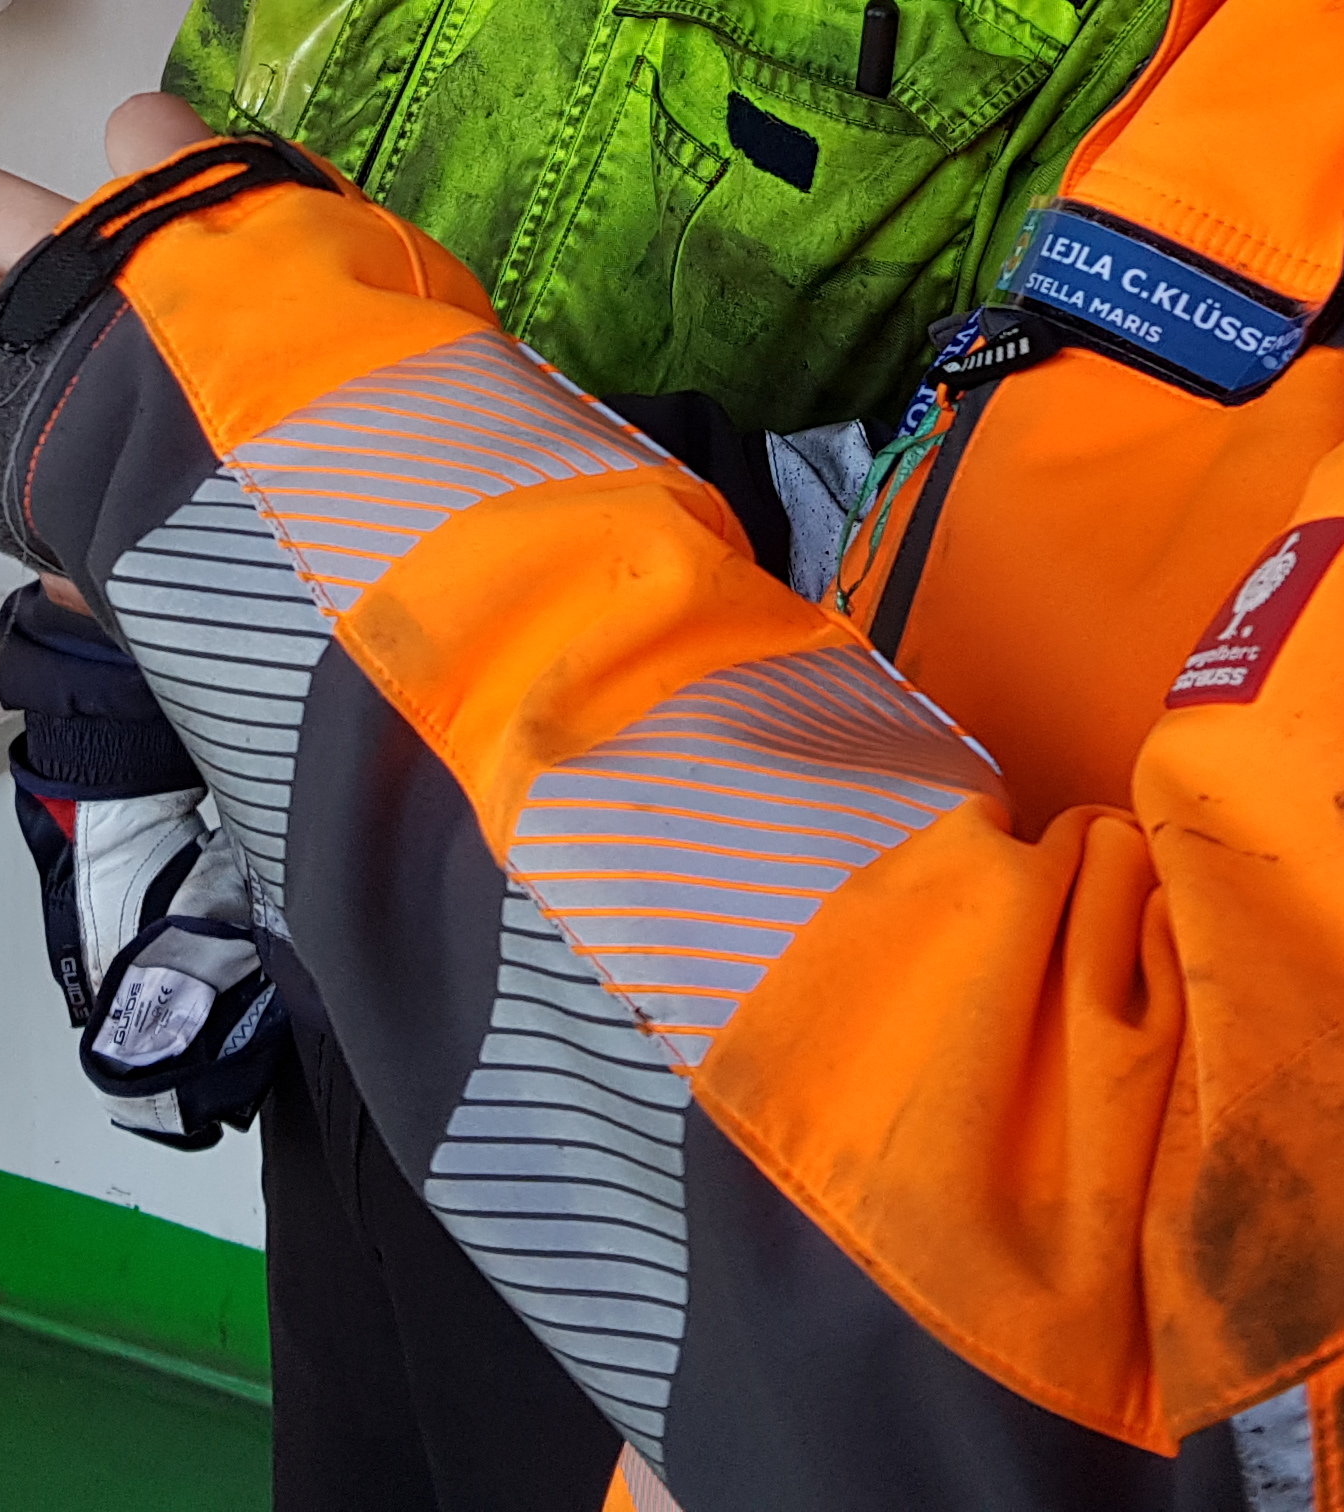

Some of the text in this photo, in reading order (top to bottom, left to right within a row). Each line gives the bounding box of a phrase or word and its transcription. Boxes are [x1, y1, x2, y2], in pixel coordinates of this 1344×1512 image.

[1039, 233, 1113, 282] LEJLA
[1025, 272, 1163, 344] STELLA MARIS
[60, 955, 91, 1020] GUIDE
[113, 982, 143, 1046] GUIDE
